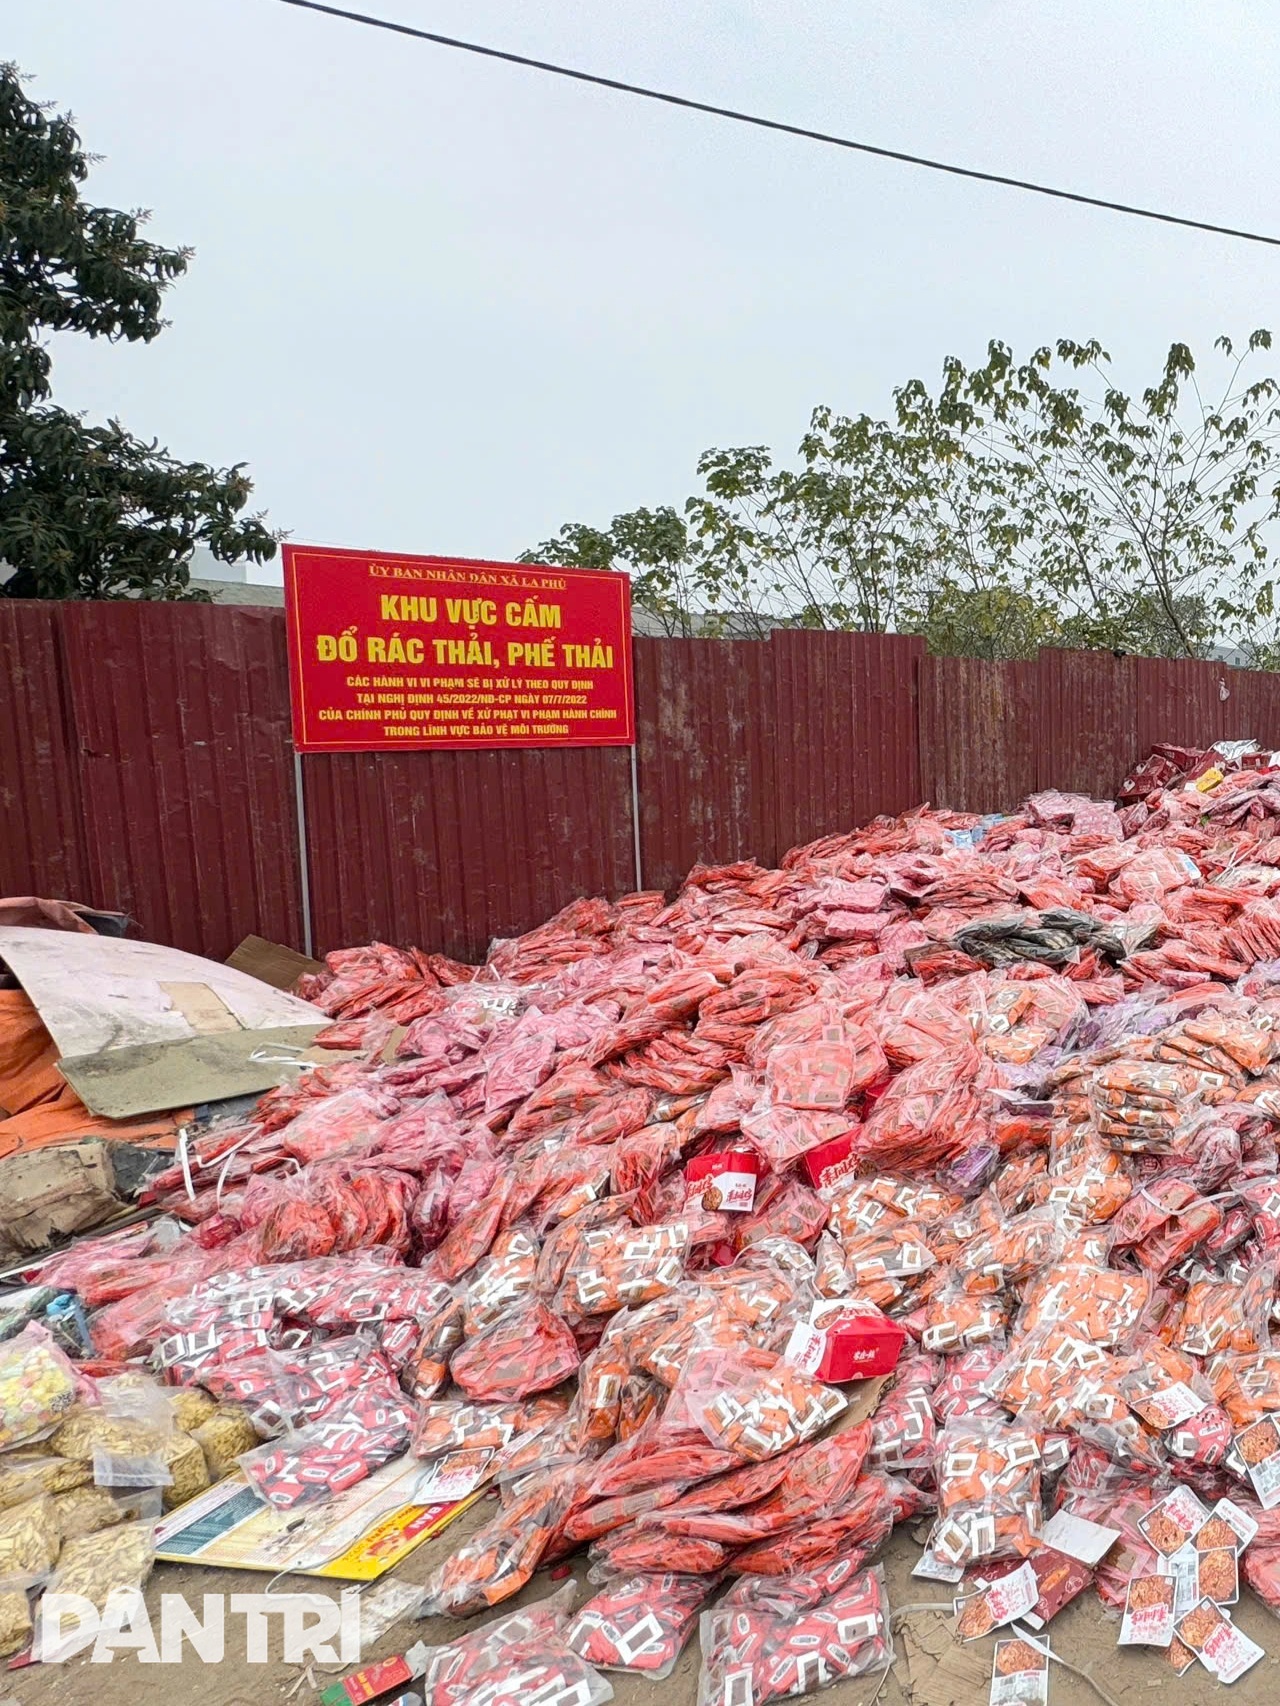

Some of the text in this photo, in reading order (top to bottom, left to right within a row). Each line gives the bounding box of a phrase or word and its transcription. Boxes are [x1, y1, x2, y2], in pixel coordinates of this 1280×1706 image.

[393, 567, 423, 579] BAN
[426, 569, 466, 582] NHÂN
[469, 572, 498, 584] DÂN
[522, 577, 540, 588] LA
[380, 594, 562, 630] KHU VỰC CẤM
[316, 625, 614, 669] ĐỔ RÁC THẢI, PHẾ THẢI
[346, 674, 370, 687] CÁC
[373, 674, 404, 687] HÀNH
[406, 677, 418, 688] VI
[420, 677, 431, 688] VI
[433, 678, 465, 690] PHẠM
[482, 678, 493, 691] BỊ
[495, 675, 510, 689] XỬ
[511, 677, 523, 689] LÝ
[525, 679, 549, 690] THEO
[551, 679, 569, 690] QUY
[571, 680, 594, 691] ĐỊNH
[356, 692, 588, 706] TẠI NGHỊ ĐỊNH 45/2022/NĐ-CP NGÀY 07/7/2022
[318, 706, 343, 721] CỦA
[345, 708, 382, 721] CHÍNH
[384, 706, 407, 720] PHỦ
[409, 709, 431, 721] QUY
[433, 709, 460, 722] ĐỊNH
[477, 706, 492, 720] XỬ
[493, 709, 519, 721] PHẠT
[520, 709, 531, 720] VI
[532, 709, 561, 721] PHẠM
[562, 707, 588, 719] HÀNH
[589, 707, 617, 719] CHÍNH
[383, 725, 420, 737] TRONG
[422, 723, 448, 736] LĨNH
[449, 725, 471, 738] VỰC
[472, 722, 494, 735] BẢO
[510, 723, 530, 735] MÔI
[532, 723, 570, 735] TRƯỜNG
